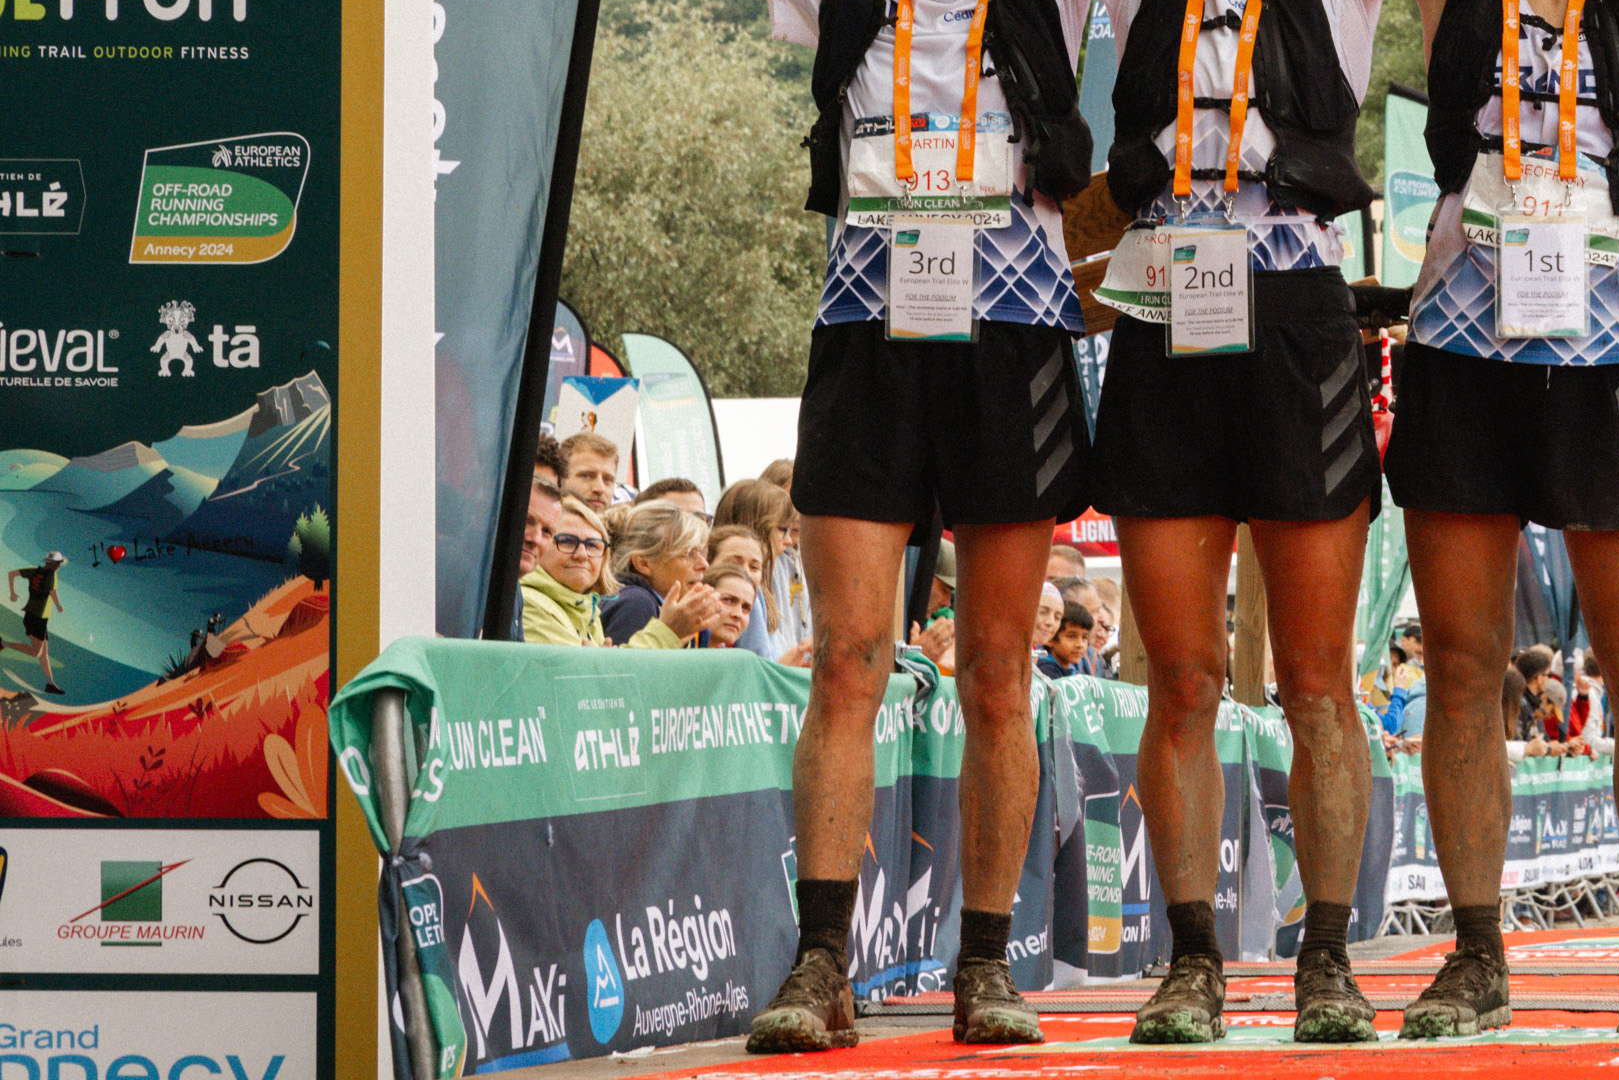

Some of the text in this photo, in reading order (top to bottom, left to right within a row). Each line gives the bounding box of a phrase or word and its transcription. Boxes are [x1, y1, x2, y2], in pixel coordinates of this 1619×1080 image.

[38, 45, 250, 60] TRAIL OUTDOOR FITNESS
[234, 146, 301, 157] EUROPEAN
[911, 138, 956, 150] ARTIN
[233, 156, 301, 167] ATHLETICS
[27, 172, 42, 181] DE
[905, 169, 951, 191] 913
[152, 183, 233, 198] OFF-ROAD
[150, 198, 224, 212] RUNNING
[1522, 195, 1564, 217] 911
[147, 213, 279, 227] CHAMPIONSHIPS
[143, 243, 234, 259] Annecy 2024
[908, 250, 956, 275] 3rd
[1524, 249, 1565, 273] 1st
[1146, 265, 1171, 288] 91
[1184, 263, 1234, 290] 2nd
[0, 376, 119, 387] TURELLE DE SAVOIE
[651, 705, 724, 754] EUROPEAN
[208, 893, 314, 909] NISSAN
[57, 924, 206, 940] GROUPE MAURIN
[616, 893, 737, 982] La Région
[632, 978, 749, 1038] Auvergne-Rhône-Alpes
